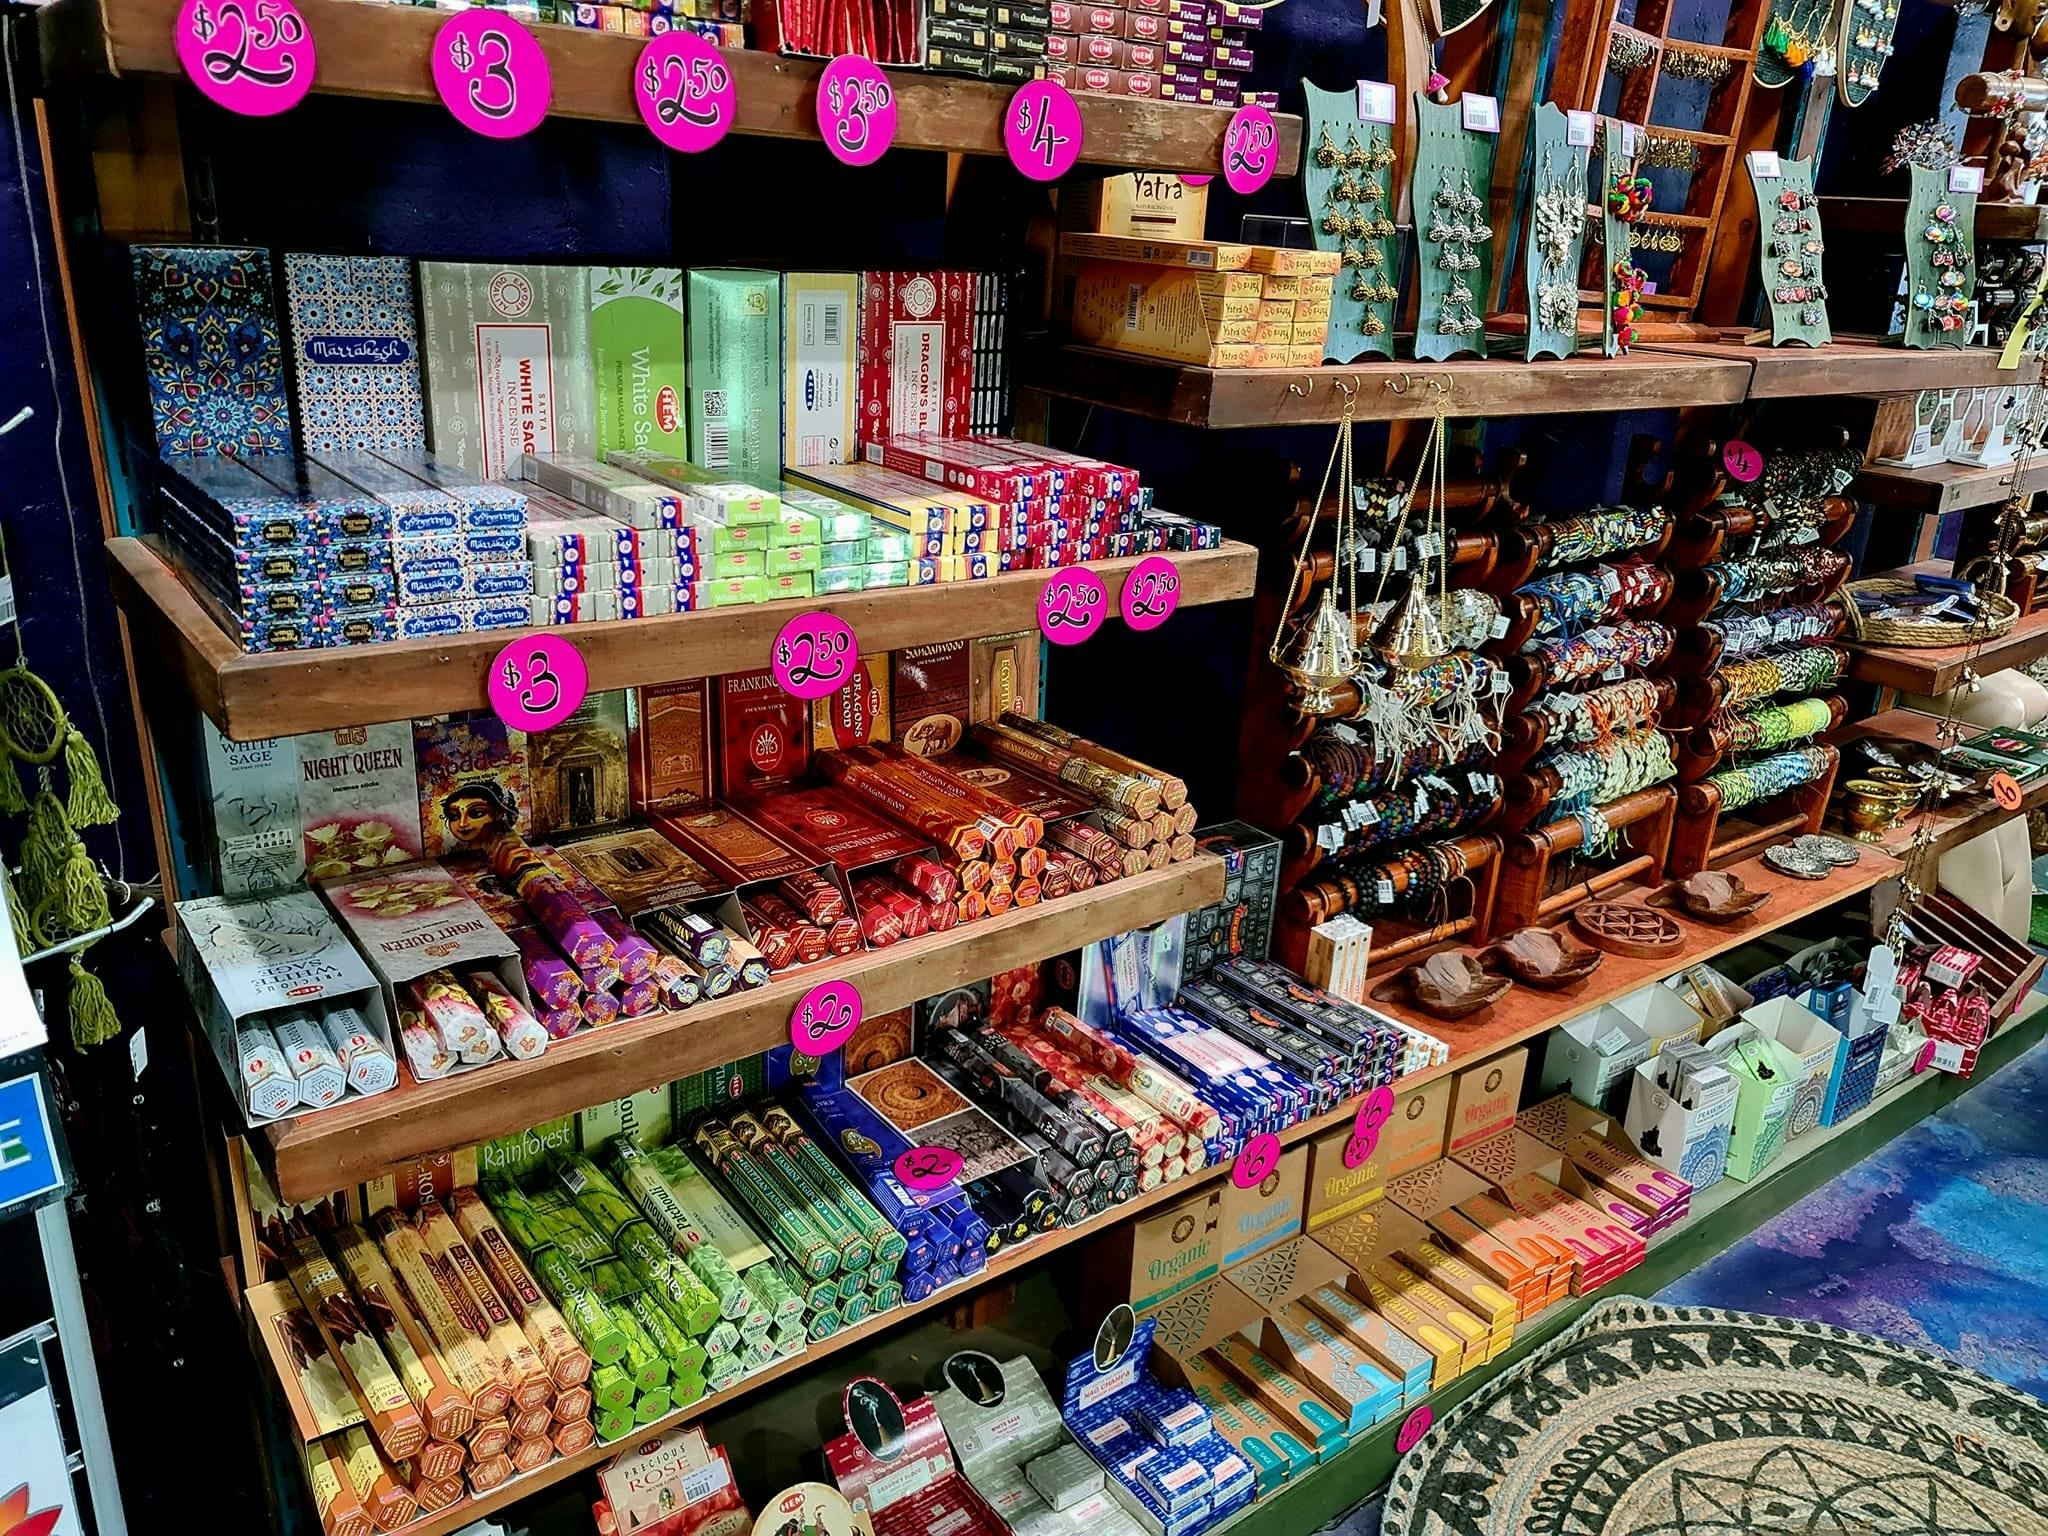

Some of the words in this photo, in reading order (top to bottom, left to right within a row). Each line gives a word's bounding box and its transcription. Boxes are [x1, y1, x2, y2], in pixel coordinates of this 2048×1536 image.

[193, 2, 302, 86] $2.50
[449, 30, 517, 118] $3
[643, 54, 727, 128] $2.50
[828, 75, 889, 152] $3.50
[1016, 96, 1069, 167] $4
[1229, 118, 1274, 176] $2.50
[1132, 172, 1183, 201] Yatra
[313, 340, 401, 362] Marrakesh
[919, 332, 931, 407] DRAGON'S
[519, 359, 533, 414] WHITE
[616, 360, 624, 396] PREMIUM
[631, 346, 650, 416] White
[806, 374, 815, 407] Satya
[507, 380, 519, 447] INCENSE
[662, 389, 673, 430] HEM
[911, 370, 919, 426] INCENSE
[1726, 446, 1753, 474] $4
[1043, 583, 1100, 628] $2.50
[1131, 570, 1177, 617] $2.50
[777, 631, 850, 687] $2.50
[502, 651, 561, 714] $3
[842, 686, 851, 728] BLOOD
[853, 672, 863, 738] DRAGONS
[220, 738, 278, 754] WHITE
[229, 750, 273, 767] SAGE
[303, 755, 350, 782] NIGHT
[352, 748, 403, 774] QUEEN
[429, 752, 526, 777] Goddess
[332, 784, 359, 793] Incense
[360, 780, 380, 790] sticks
[859, 781, 886, 800] DRAGONS
[885, 796, 906, 812] BLOOD
[918, 769, 946, 788] DRAGONS
[945, 781, 966, 797] BLOOD
[824, 829, 901, 854] FRANKINCENSE
[749, 862, 806, 880] CHANDAN
[379, 932, 436, 953] QUEEN
[437, 919, 485, 939] NIGHT
[657, 911, 694, 941] DARSHAN
[251, 965, 339, 985] WHITE
[258, 958, 322, 977] SAGE
[802, 993, 853, 1042] $2
[732, 1076, 741, 1097] HEM
[1362, 1097, 1382, 1129] $6
[483, 1122, 571, 1170] Rainforest
[902, 1153, 954, 1177] $2
[1244, 1142, 1268, 1178] $6
[776, 1153, 803, 1181] JASMINE
[799, 1179, 824, 1210] EGIPCIO
[807, 1144, 840, 1173] EGYPTIAN
[837, 1170, 864, 1202] JASMINE
[1323, 1161, 1379, 1198] Organic
[1585, 1150, 1634, 1182] Organic
[740, 1155, 771, 1192] EGYPTIAN
[766, 1185, 792, 1220] JASMINE
[651, 1185, 692, 1233] Patchouli
[490, 1230, 530, 1291] SANDAL-ROSE
[630, 1239, 684, 1302] Rainforest
[1147, 1238, 1211, 1281] Organic
[1419, 1243, 1471, 1281] Organic
[457, 1252, 498, 1311] SANDAL-ROSE
[547, 1262, 597, 1325] Rainforest
[1396, 1270, 1449, 1309] Organic
[1370, 1281, 1419, 1323] Organic
[1083, 1386, 1100, 1399] NAG
[1100, 1370, 1131, 1390] CHAMPA
[1249, 1353, 1299, 1397] Organic
[624, 1443, 686, 1480] PRECIOUS
[641, 1441, 661, 1455] HEM
[629, 1456, 691, 1493] ROSE
[781, 1494, 805, 1513] HEM
